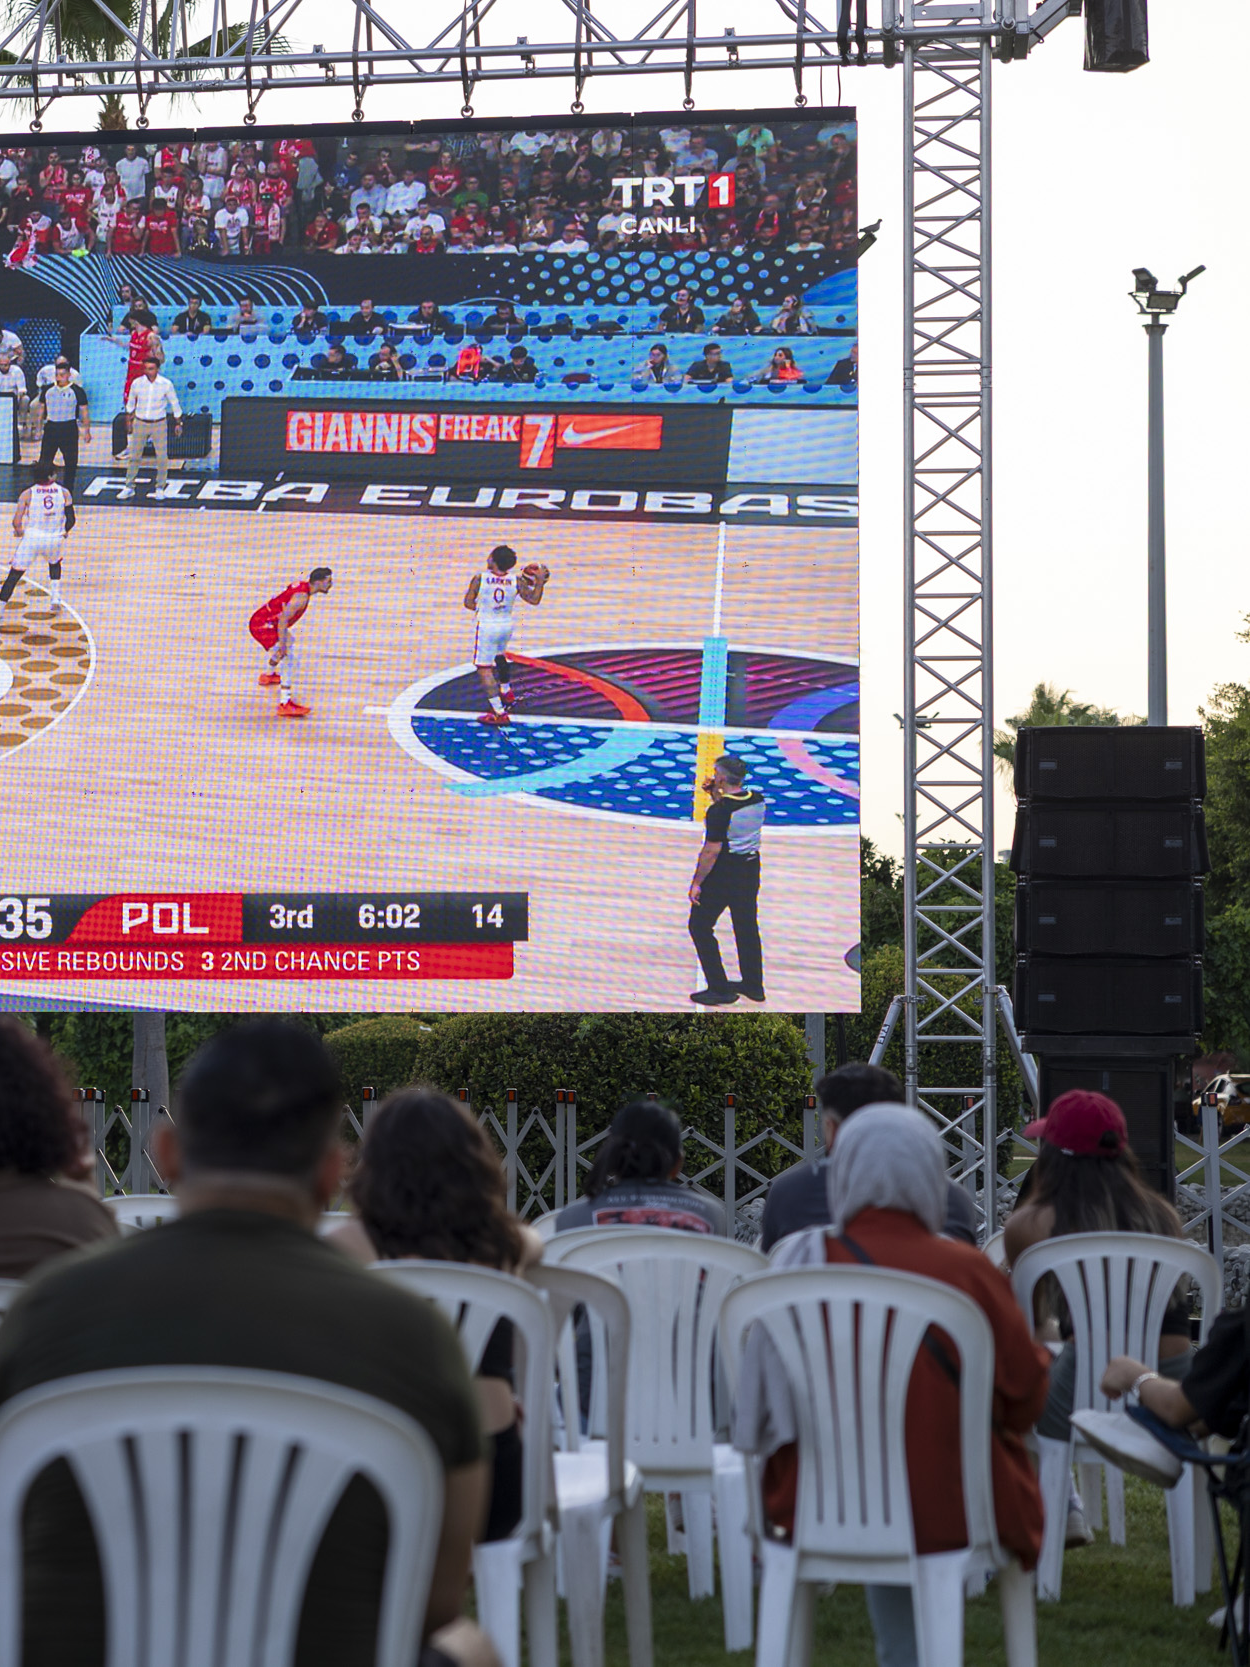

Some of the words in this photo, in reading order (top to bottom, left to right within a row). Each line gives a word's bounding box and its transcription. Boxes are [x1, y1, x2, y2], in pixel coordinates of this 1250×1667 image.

[611, 175, 705, 208] TRT
[712, 175, 730, 206] 1
[619, 215, 696, 235] CANLI
[287, 411, 437, 454] GIANNIS
[439, 414, 520, 441] FREAK
[524, 415, 554, 467] 7
[82, 475, 331, 504] FIBA
[358, 483, 858, 518] EUROBAS
[493, 587, 505, 604] 0
[122, 902, 210, 935] POL
[269, 903, 314, 929] 3rd
[358, 903, 421, 929] 6:02
[471, 903, 505, 929] 14
[57, 951, 185, 972] REBOUNDS
[201, 951, 215, 972] 3
[221, 951, 267, 972] 2ND
[274, 951, 371, 972] CHANCE
[377, 951, 421, 972] PTS
